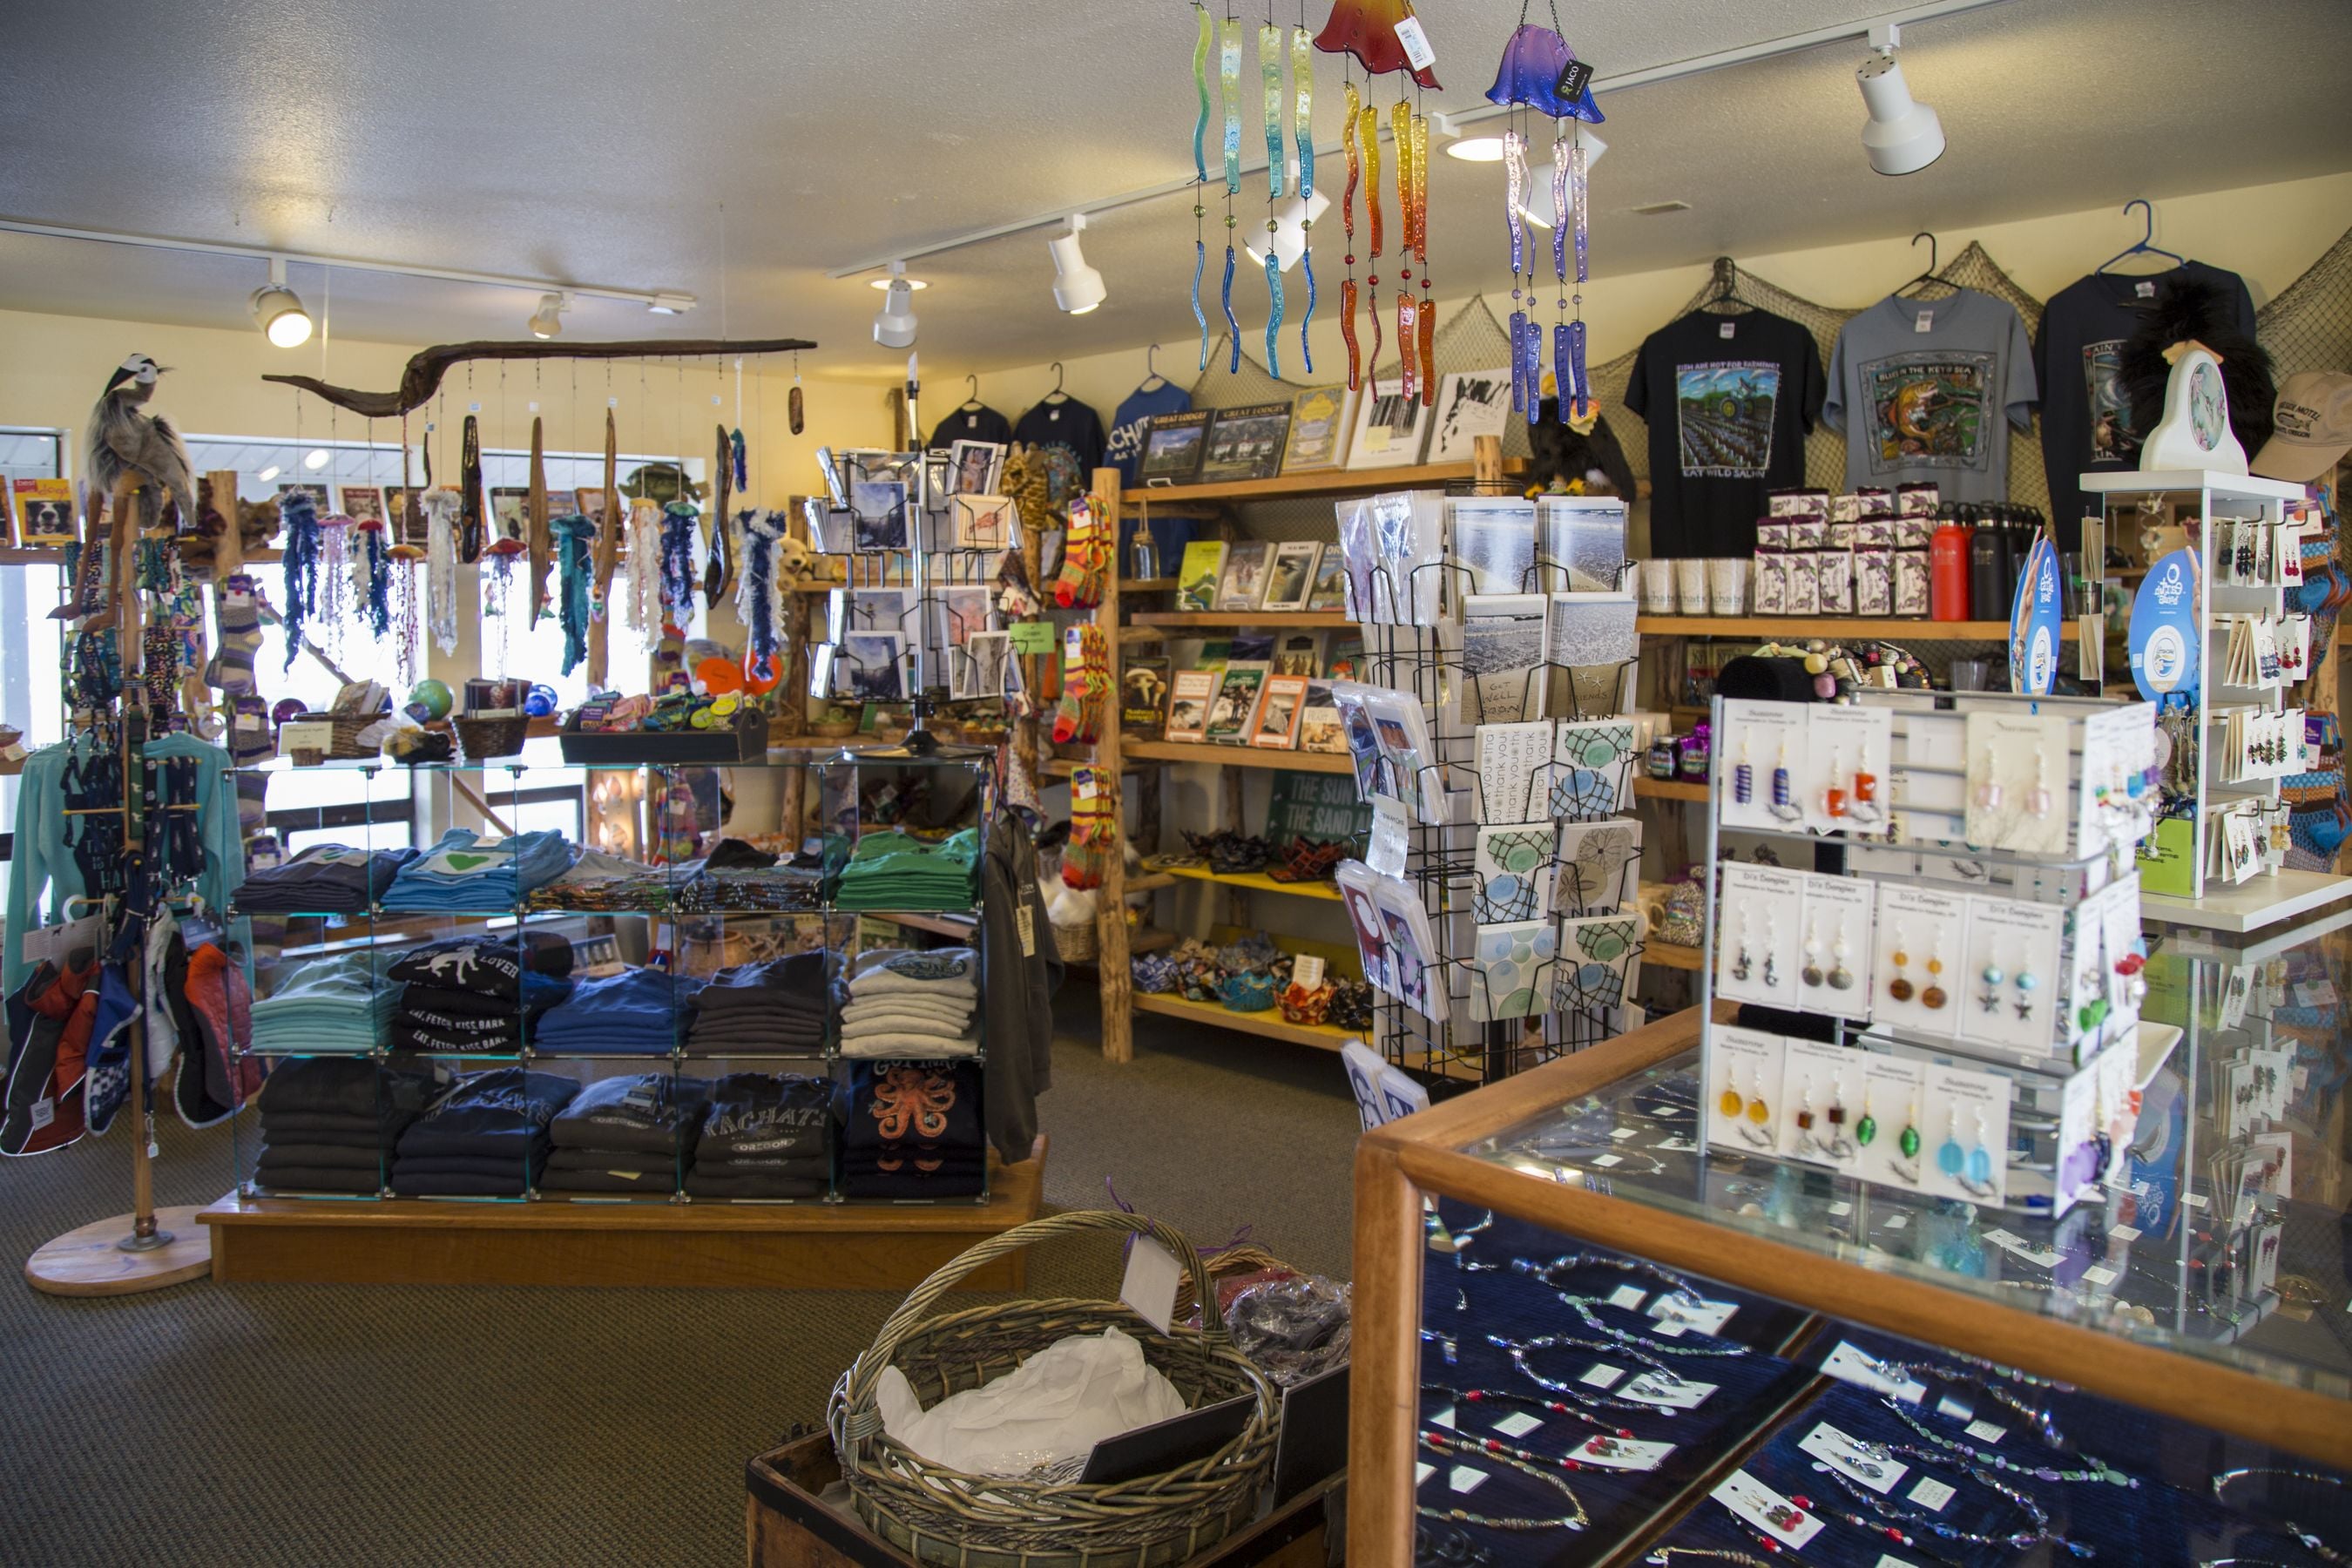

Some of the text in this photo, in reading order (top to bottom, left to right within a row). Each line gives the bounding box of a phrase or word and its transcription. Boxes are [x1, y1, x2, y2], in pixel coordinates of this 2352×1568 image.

[1565, 66, 1579, 87] JACO
[1897, 368, 1907, 377] IN
[1909, 366, 1925, 375] THE
[1928, 365, 1944, 374] KEY
[1954, 365, 1971, 375] SEA
[1154, 411, 1207, 424] GREAT LODGES
[1223, 404, 1285, 419] GREAT LODGES
[2295, 406, 2321, 422] MOTEL
[2288, 429, 2311, 438] OREGON
[1683, 469, 1703, 478] EAT
[1707, 469, 1732, 478] WILD
[1490, 682, 1511, 692] GET
[1483, 691, 1517, 704] WELL
[1483, 704, 1520, 716] SOON
[1498, 736, 1508, 758] you
[1524, 733, 1535, 767] thank
[1538, 738, 1548, 761] you
[1484, 767, 1492, 788] you
[1511, 757, 1519, 780] you
[1495, 762, 1505, 797] thank
[1291, 774, 1354, 804] THE SUN
[1506, 783, 1517, 818] thank
[1286, 803, 1314, 829] THE
[1315, 806, 1353, 835] SAND
[480, 955, 520, 979] LOVER
[478, 1018, 505, 1030] BARK
[739, 1139, 787, 1152] OREGON
